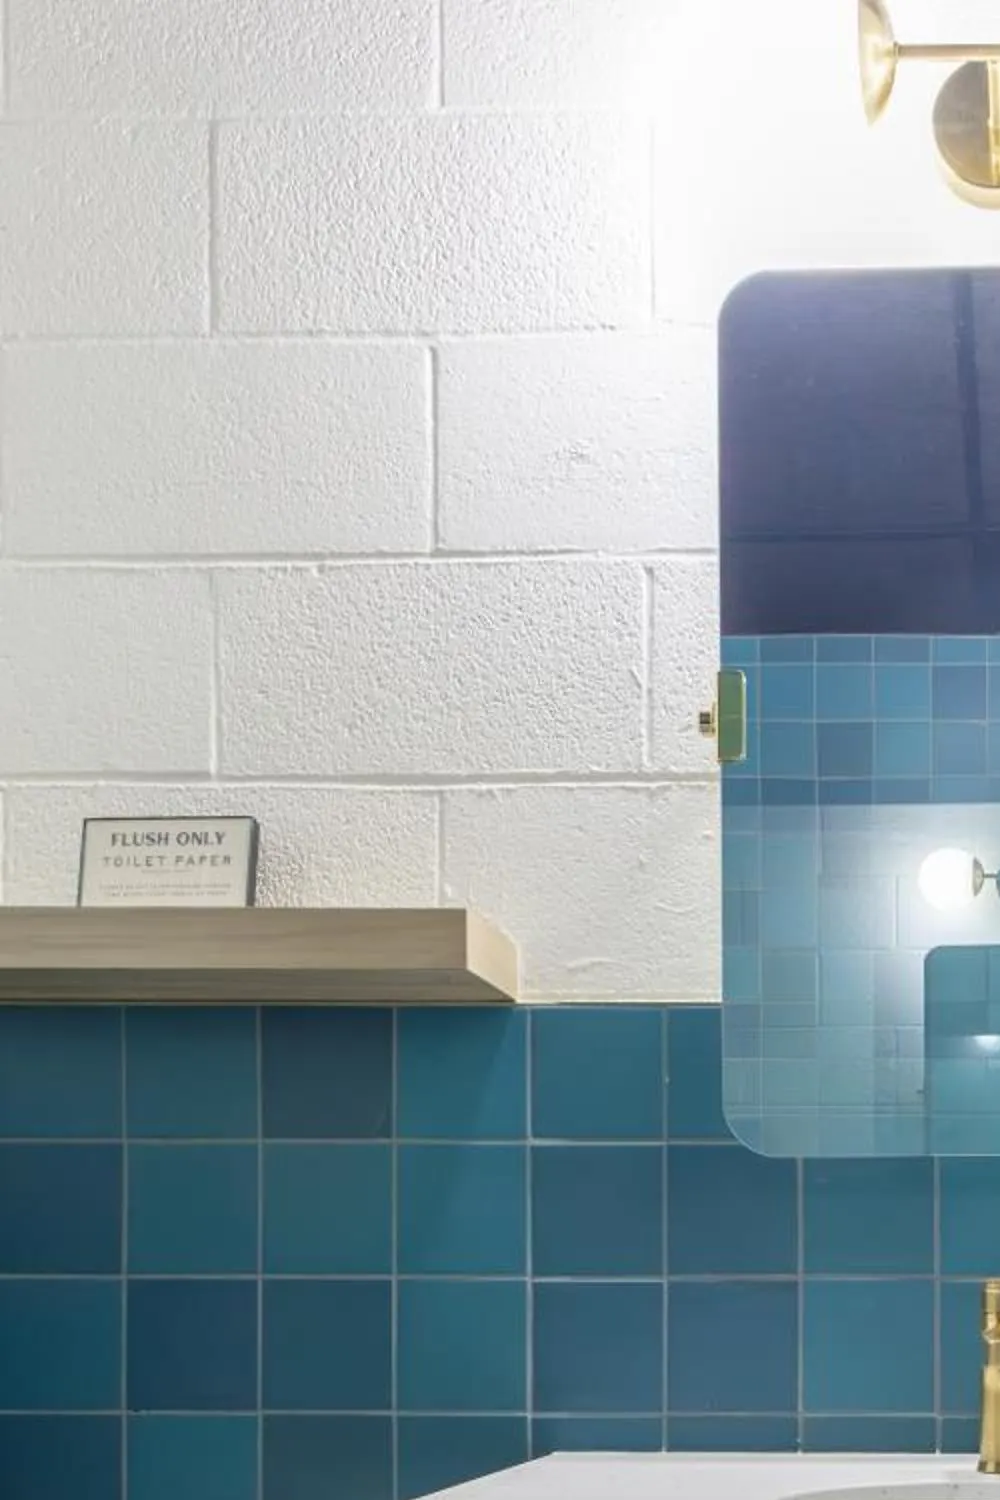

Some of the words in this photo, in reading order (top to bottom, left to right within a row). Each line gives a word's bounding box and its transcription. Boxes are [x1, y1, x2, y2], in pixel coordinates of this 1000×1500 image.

[111, 832, 169, 847] FLUSH
[176, 831, 226, 846] ONLY
[104, 855, 164, 867] TOILET
[175, 855, 231, 867] PAPER
